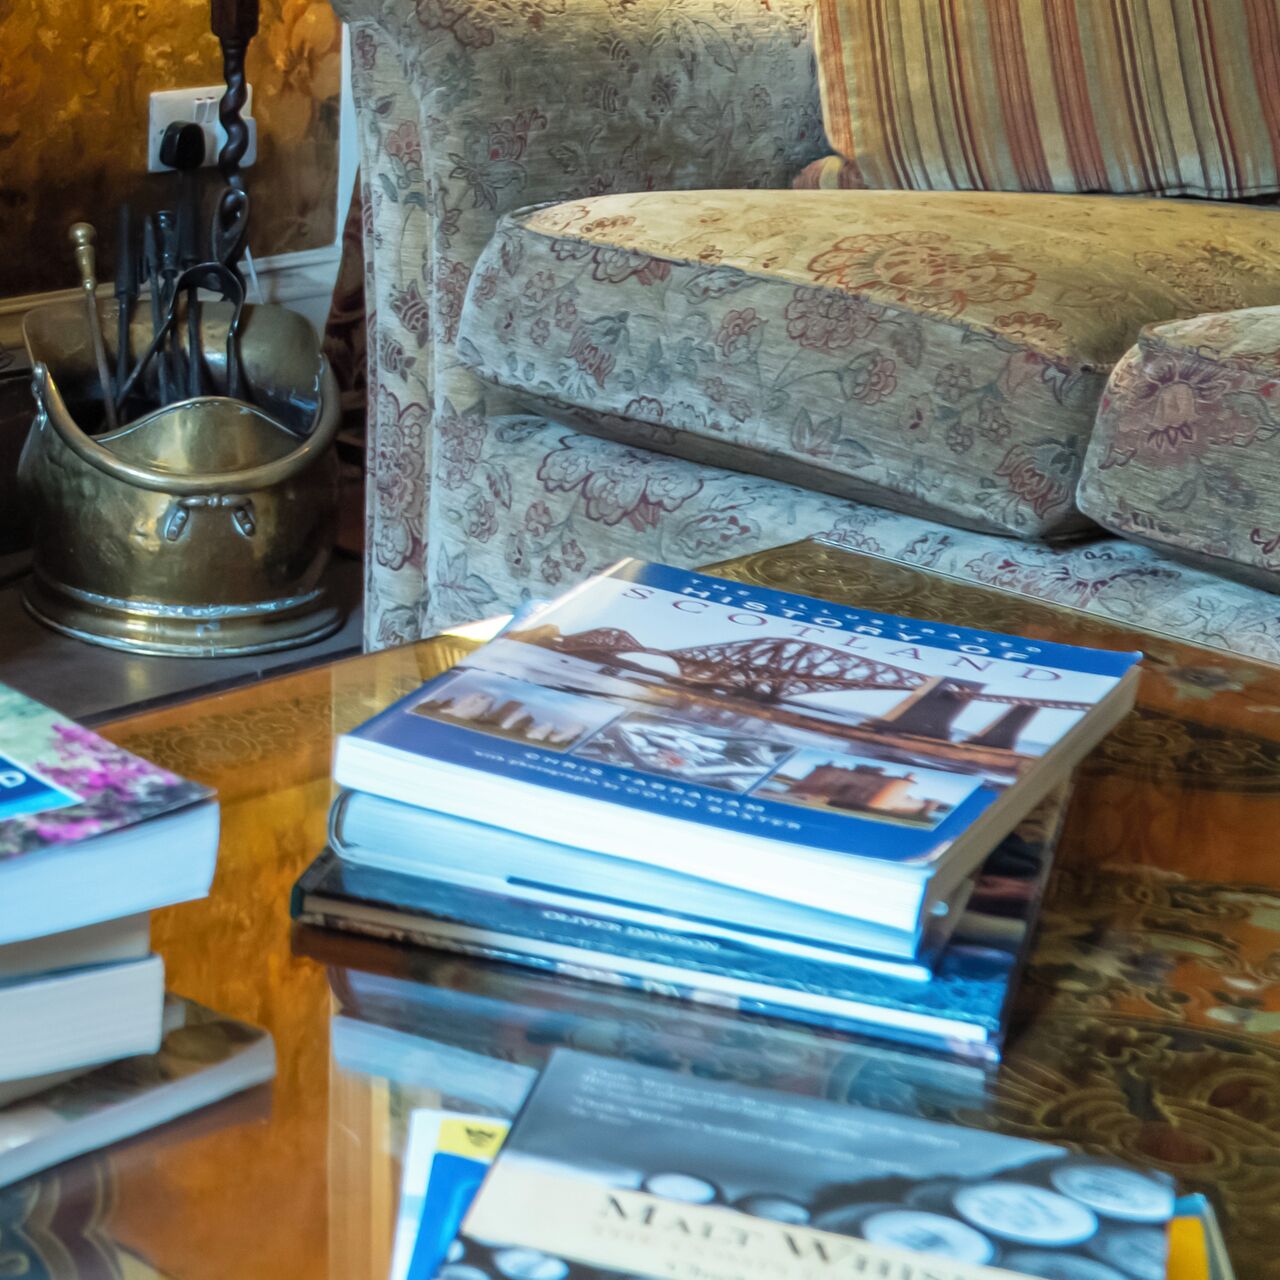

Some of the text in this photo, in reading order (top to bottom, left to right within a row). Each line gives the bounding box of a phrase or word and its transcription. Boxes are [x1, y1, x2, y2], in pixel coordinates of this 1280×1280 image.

[622, 587, 1062, 681] SCOTLAND
[682, 586, 1030, 660] HISTORY OF
[691, 578, 1042, 653] THE ILLUSTRATED
[524, 752, 603, 776] CHRIS
[600, 1193, 765, 1248] MALT
